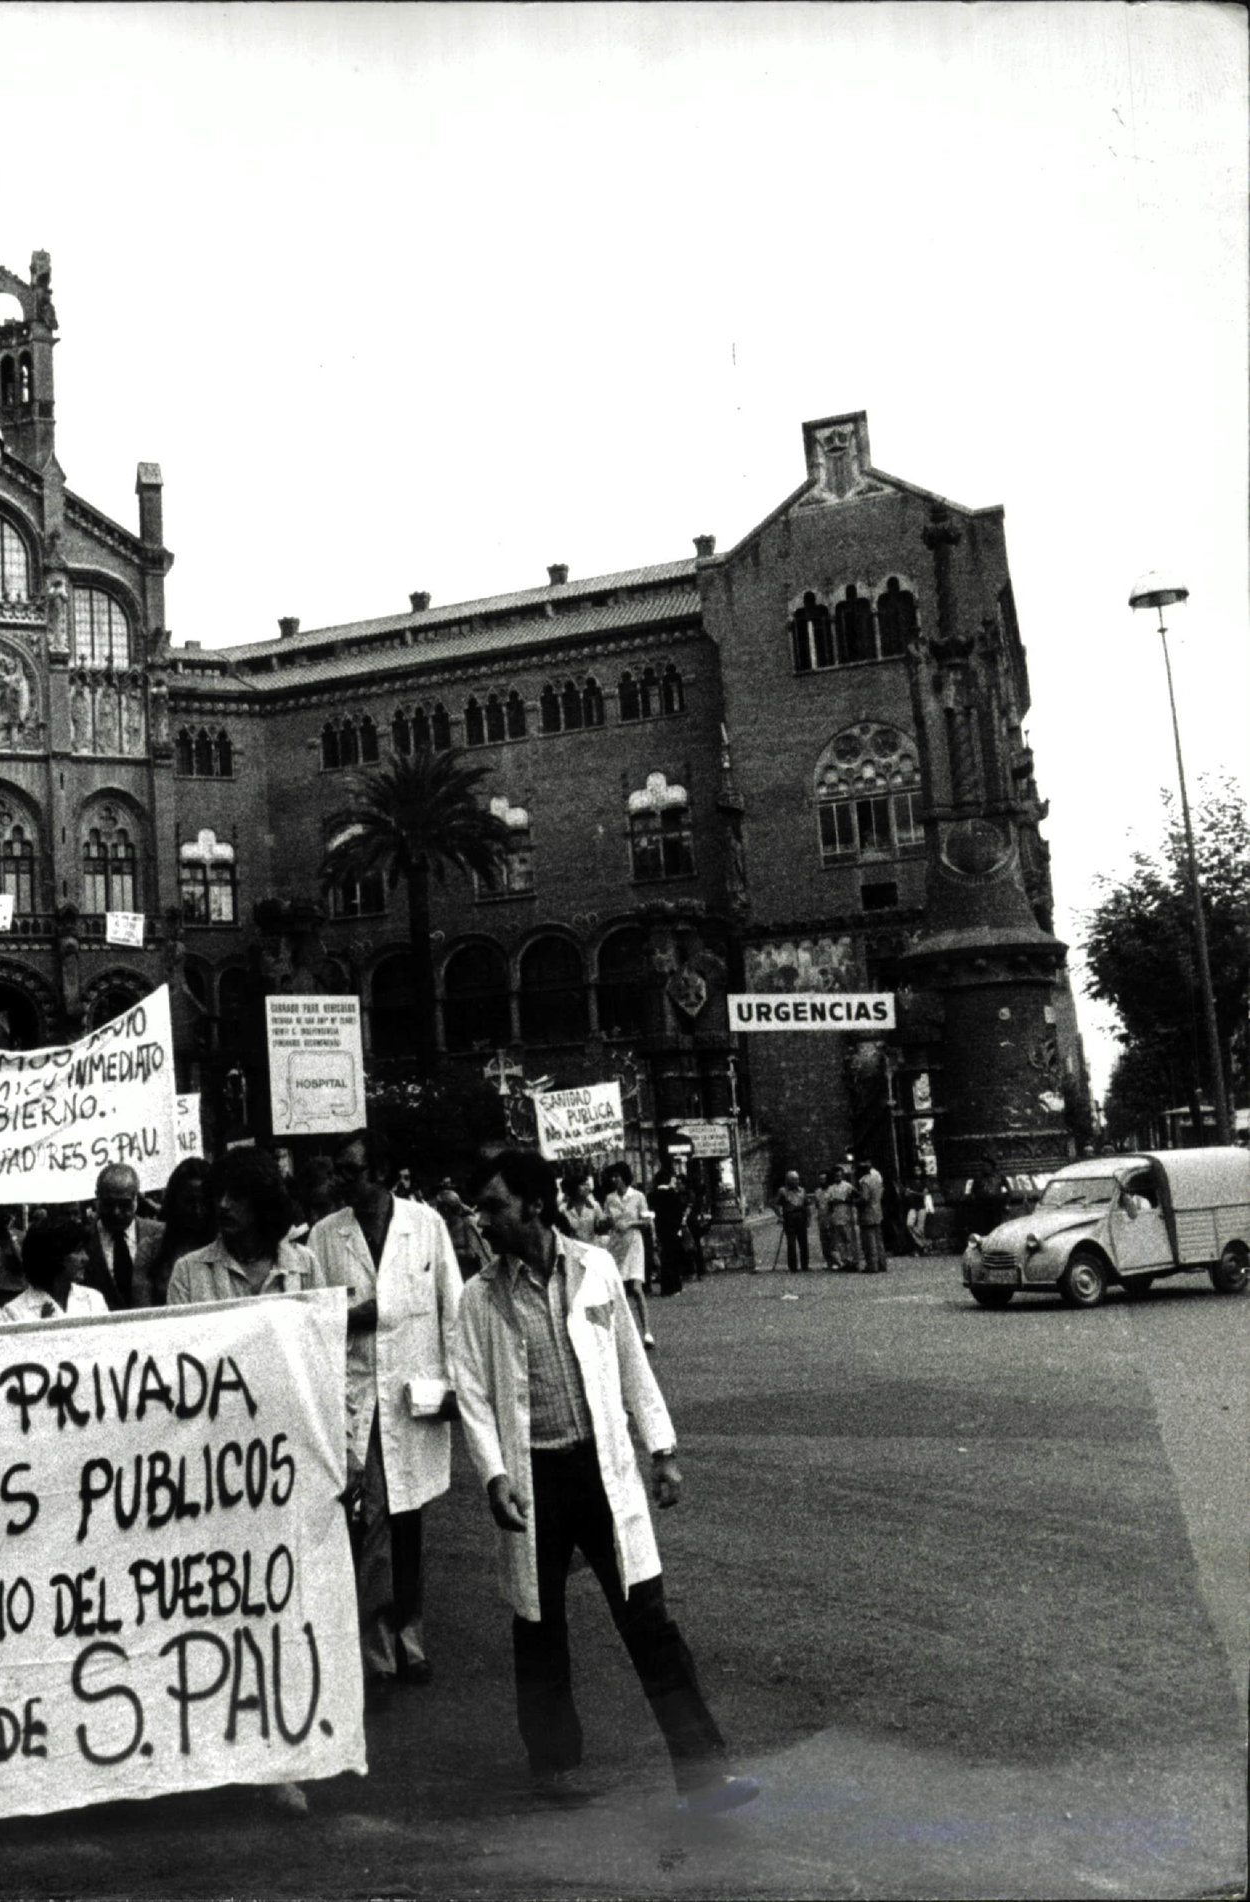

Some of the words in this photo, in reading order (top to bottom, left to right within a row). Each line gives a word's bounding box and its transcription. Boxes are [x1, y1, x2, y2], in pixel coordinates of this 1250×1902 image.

[736, 1001, 888, 1022] URGENCIAS
[68, 1041, 165, 1090] INMEDIATO
[296, 1078, 347, 1089] HOSPITAL
[540, 1089, 592, 1111] SANIDAD
[567, 1101, 615, 1127] PUBLICA
[75, 1432, 296, 1542] PUBLICOS
[50, 1566, 124, 1638] DEL
[129, 1543, 294, 1627] PUEBLO
